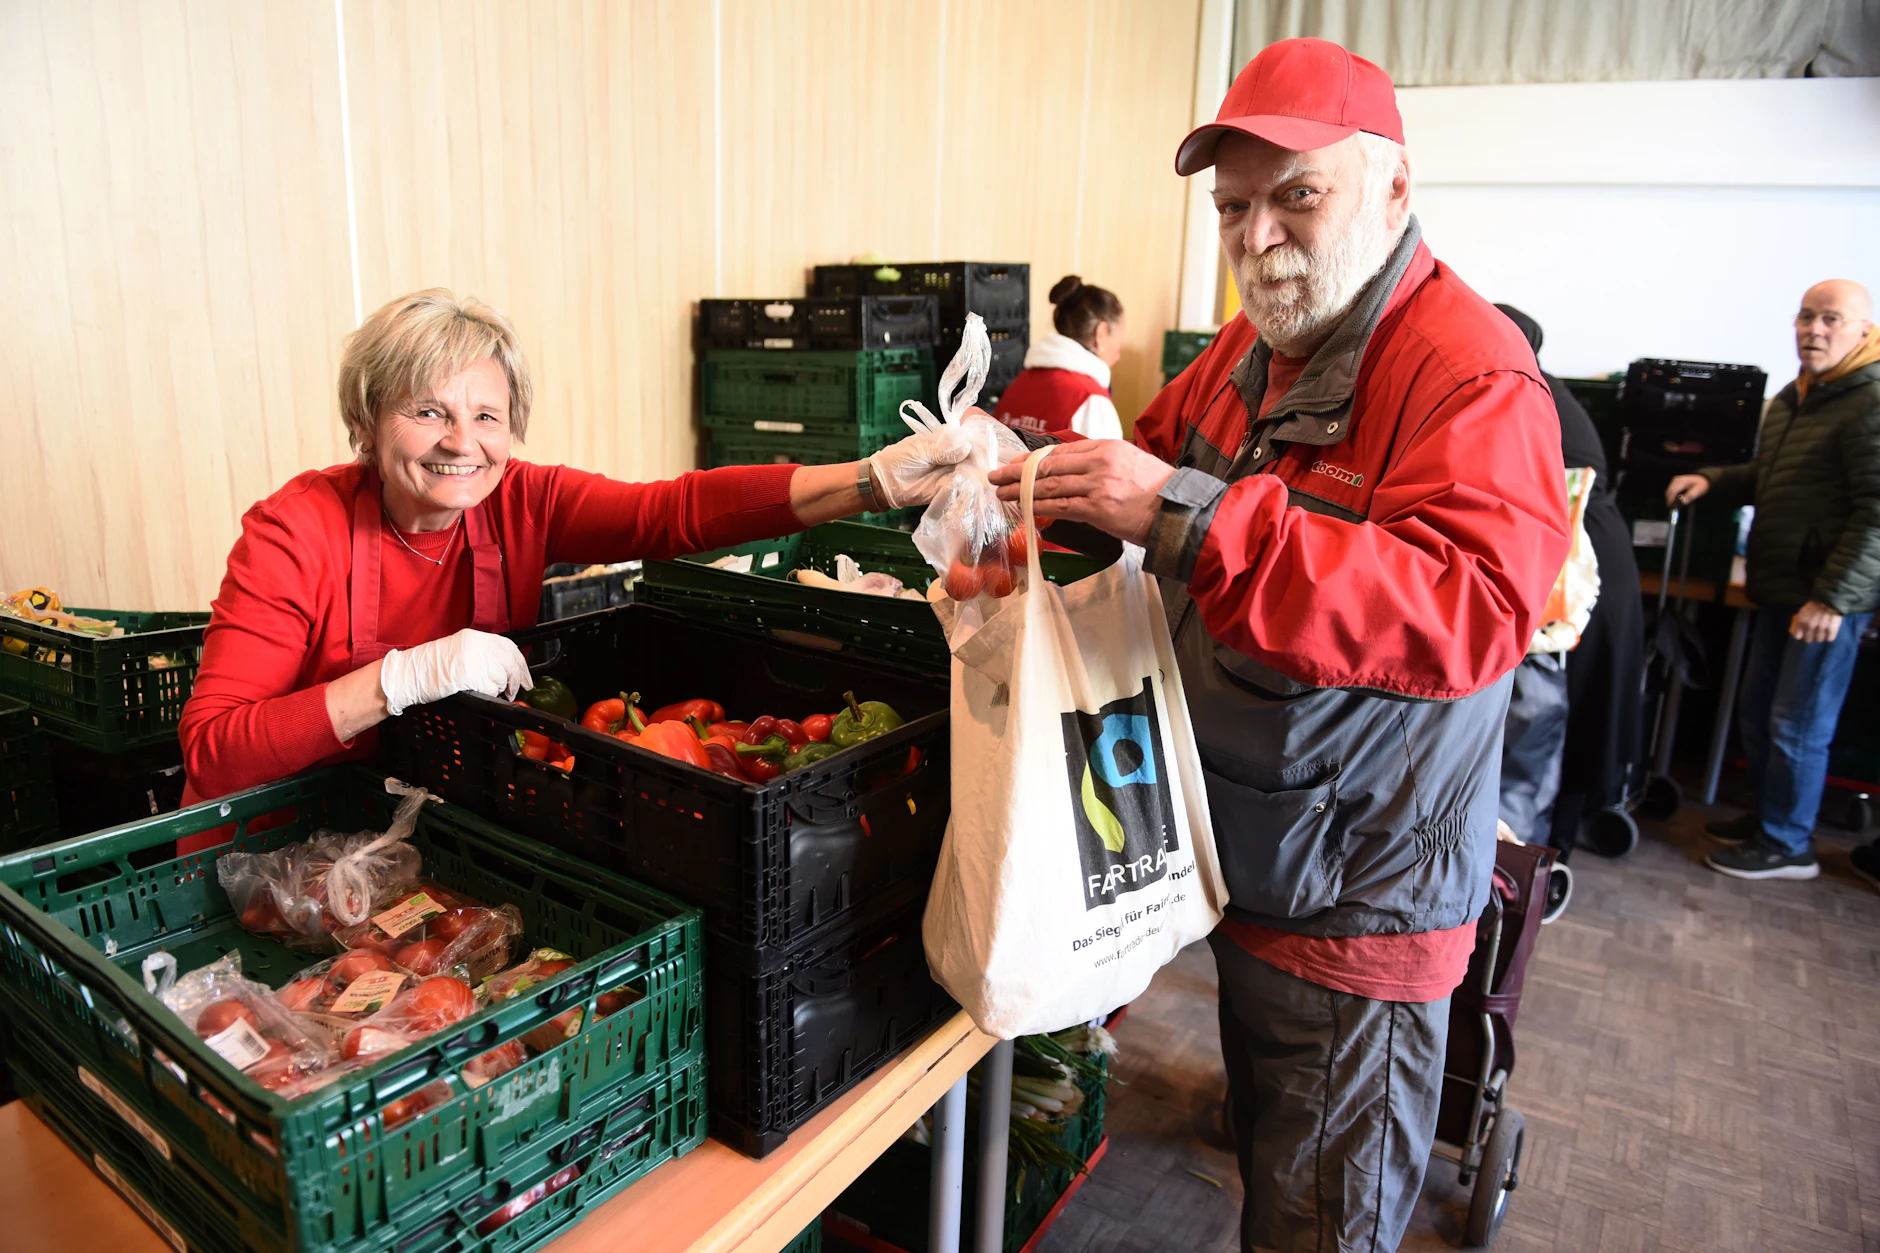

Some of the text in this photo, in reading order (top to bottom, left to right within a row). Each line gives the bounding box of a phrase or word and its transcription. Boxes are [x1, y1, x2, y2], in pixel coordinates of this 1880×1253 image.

[1311, 460, 1355, 484] toom
[1072, 934, 1094, 952] Das
[1124, 909, 1143, 924] für
